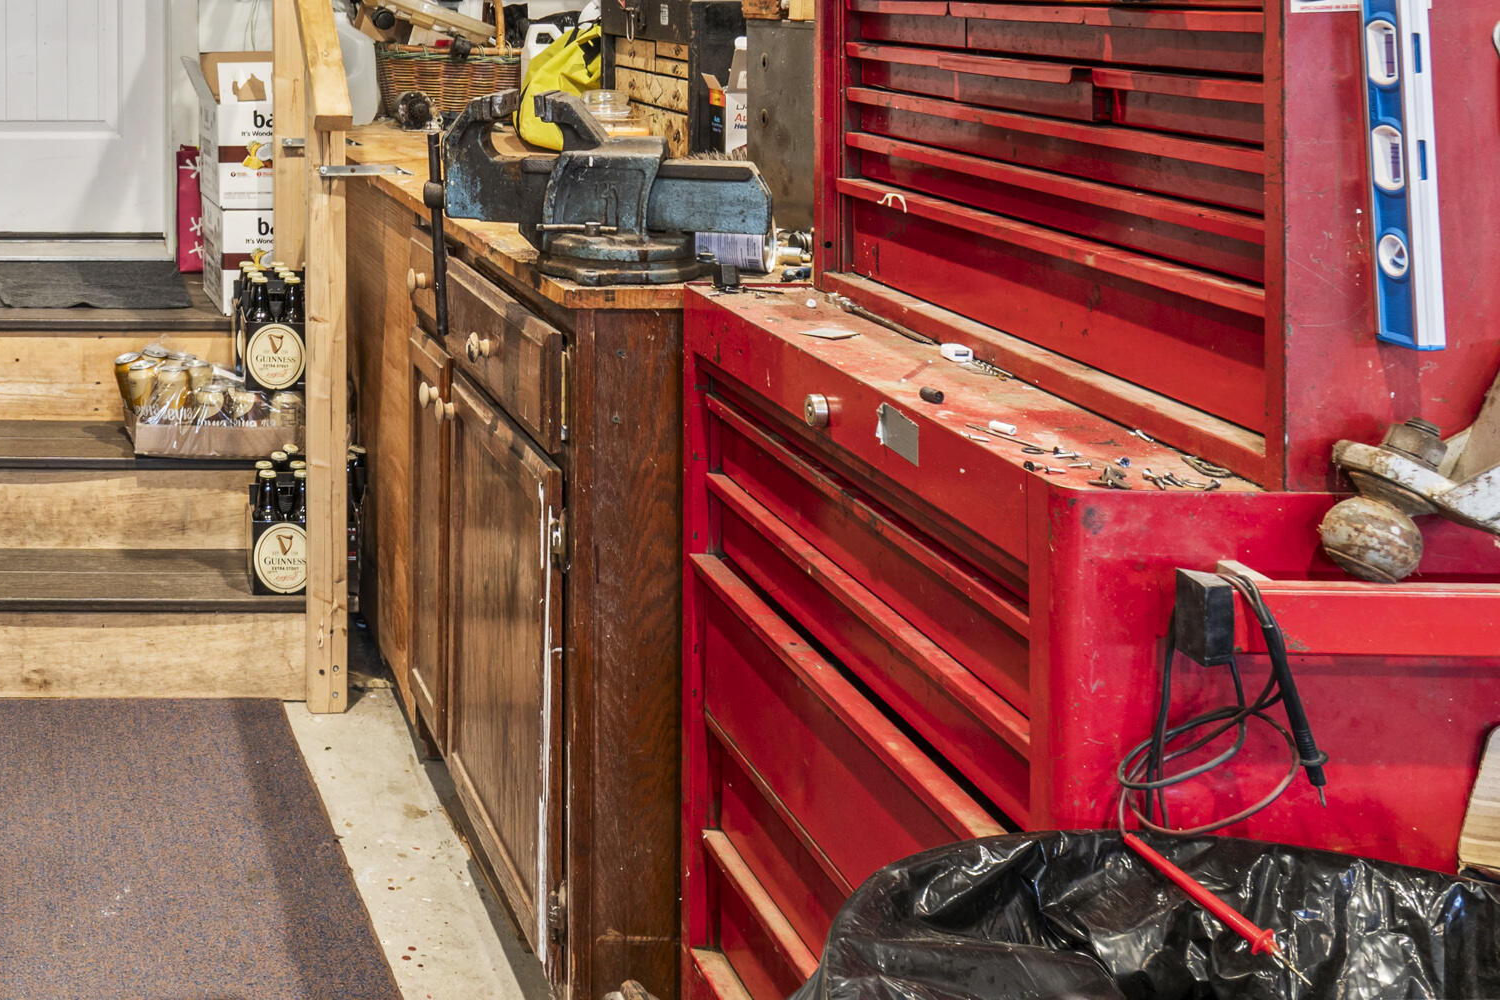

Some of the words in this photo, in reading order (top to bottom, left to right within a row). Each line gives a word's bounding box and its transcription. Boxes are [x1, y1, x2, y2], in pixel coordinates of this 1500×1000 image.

[253, 110, 274, 129] ba
[255, 354, 296, 364] GUINNESS
[263, 556, 306, 566] GUINNESS
